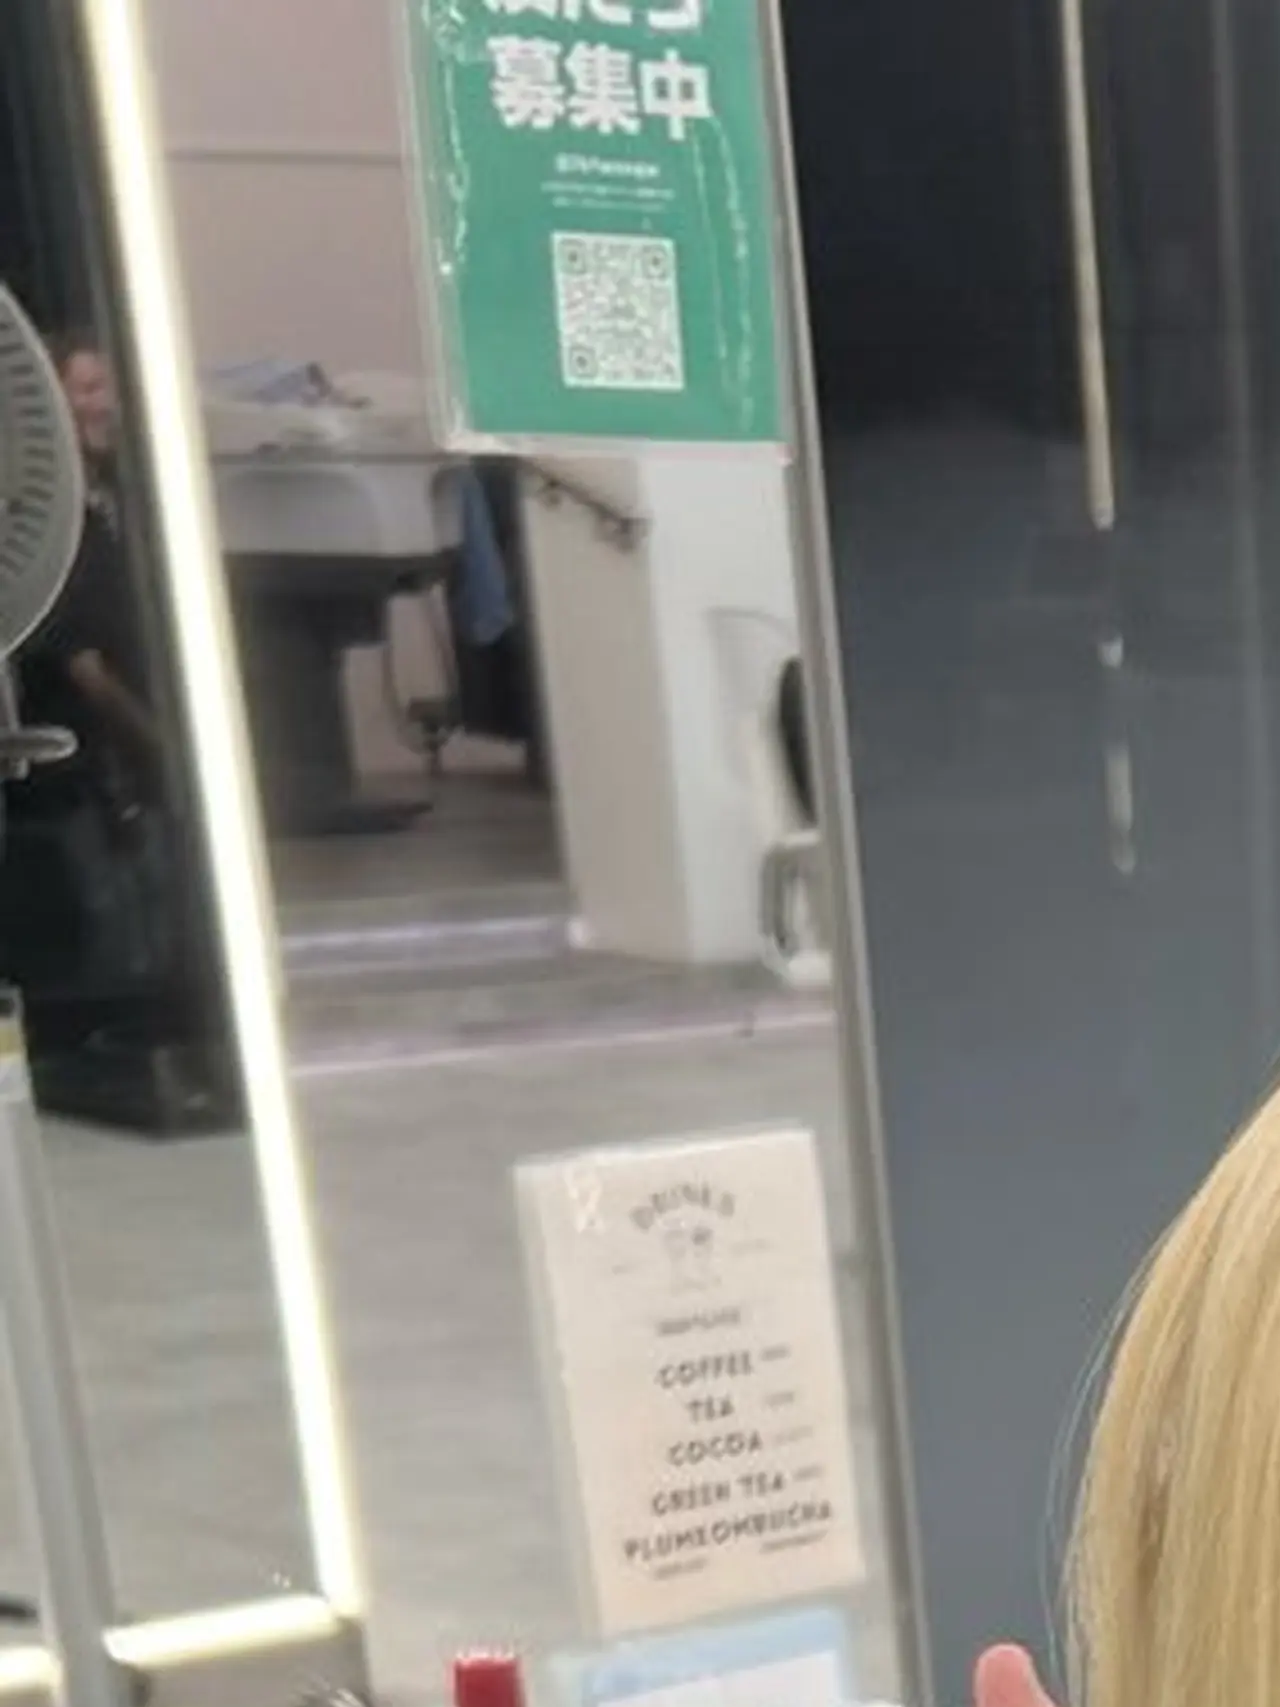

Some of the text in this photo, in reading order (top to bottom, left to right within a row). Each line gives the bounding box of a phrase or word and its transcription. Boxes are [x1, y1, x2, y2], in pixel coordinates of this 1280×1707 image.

[486, 36, 713, 141] 募集中
[657, 1352, 753, 1388] COFFEE
[687, 1398, 733, 1423] TEA
[669, 1432, 762, 1466] COCOA
[652, 1474, 785, 1516] GREEN TEA
